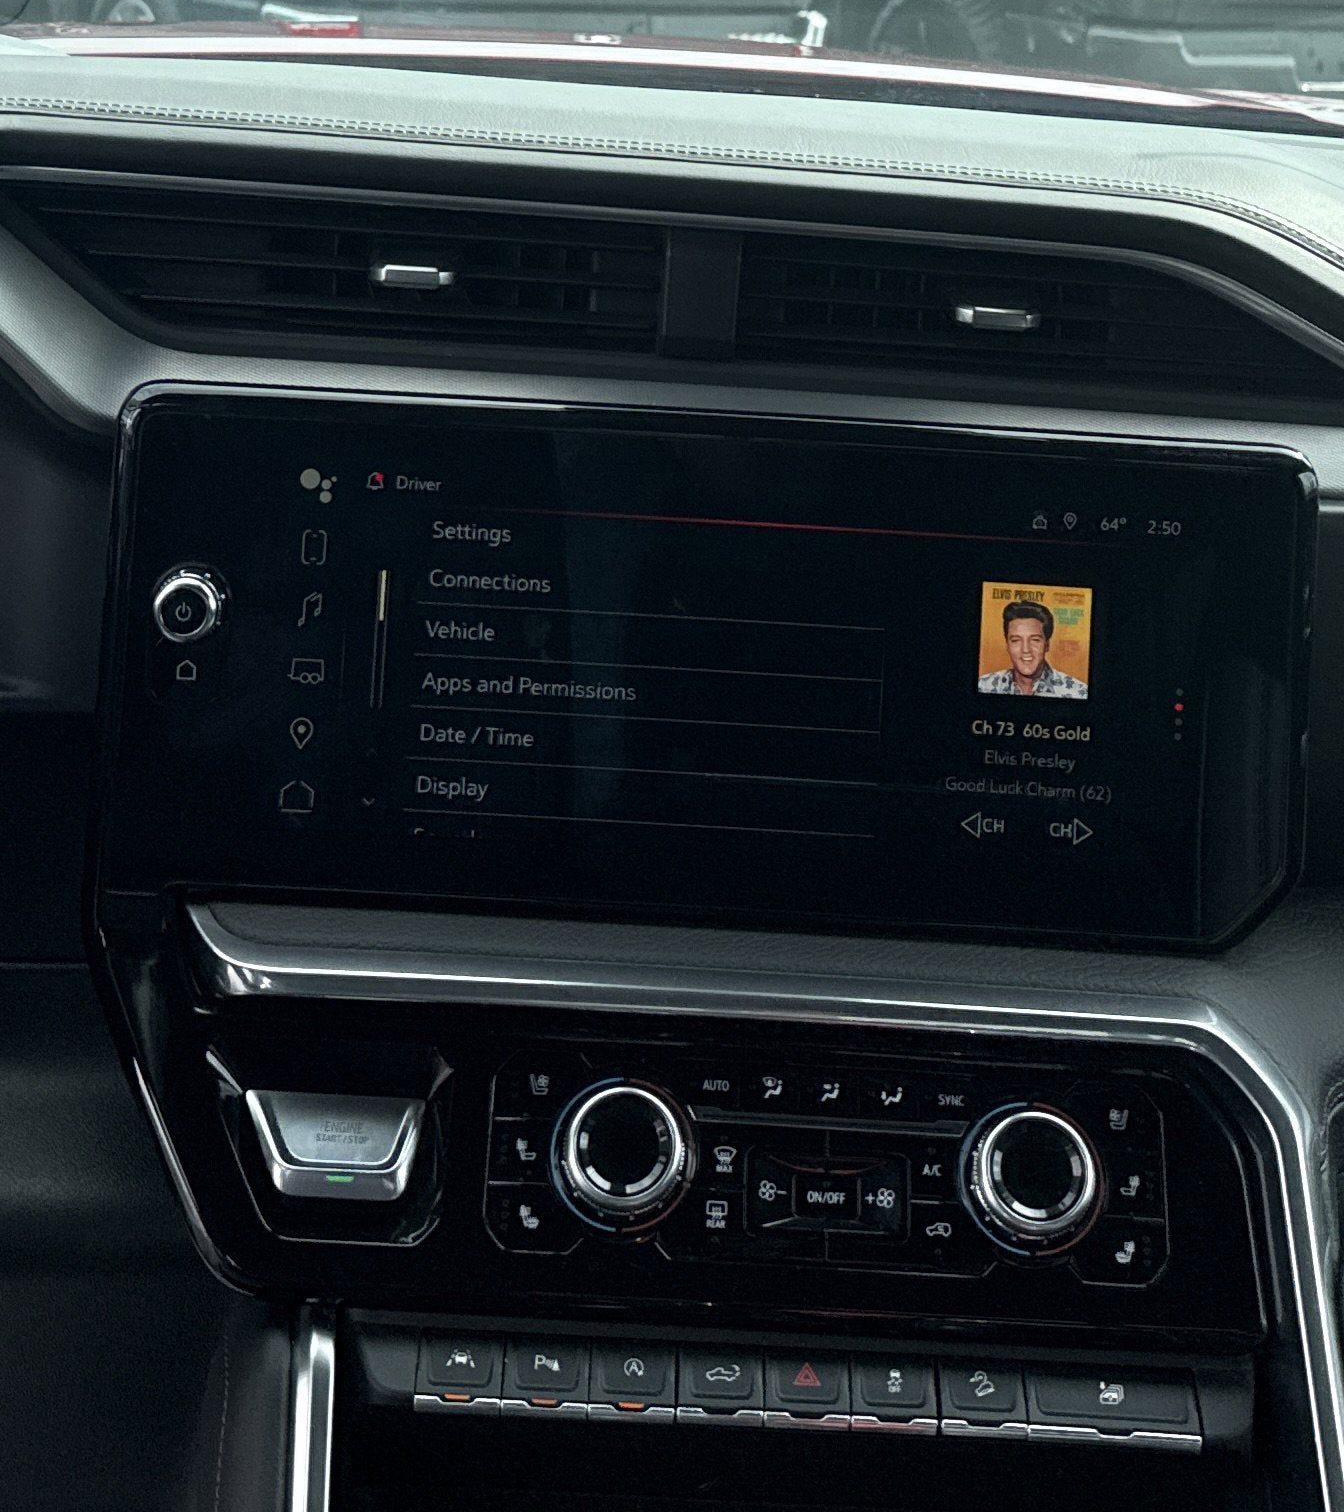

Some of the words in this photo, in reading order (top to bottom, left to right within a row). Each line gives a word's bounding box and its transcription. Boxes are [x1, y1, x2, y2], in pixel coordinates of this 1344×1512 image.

[396, 475, 442, 493] Driver
[432, 520, 512, 546] Settings
[1147, 520, 1181, 537] 2:50
[429, 569, 551, 594] Connections
[425, 620, 496, 643] Vehicle
[422, 673, 472, 697] Apps
[477, 675, 513, 695] and
[519, 678, 637, 702] Permissions
[419, 723, 467, 745] Date
[486, 727, 535, 748] Time
[972, 720, 993, 736] Ch
[996, 721, 1014, 737] 73
[1023, 722, 1050, 739] 60s
[1054, 723, 1091, 742] Gold
[985, 751, 1017, 767] Elvis
[1022, 752, 1076, 773] Presley
[416, 776, 490, 801] Display
[945, 777, 986, 794] Good
[990, 780, 1023, 797] Luck
[1027, 782, 1075, 800] Charm
[1080, 785, 1112, 803] (62)
[982, 818, 1005, 834] CH
[1049, 823, 1072, 838] CH
[702, 1079, 730, 1092] AUTO
[938, 1093, 965, 1107] SYNC
[324, 1120, 364, 1134] ENGINE
[921, 1163, 943, 1177] A/C
[807, 1190, 847, 1205] ON/OFF
[706, 1219, 726, 1229] REAR
